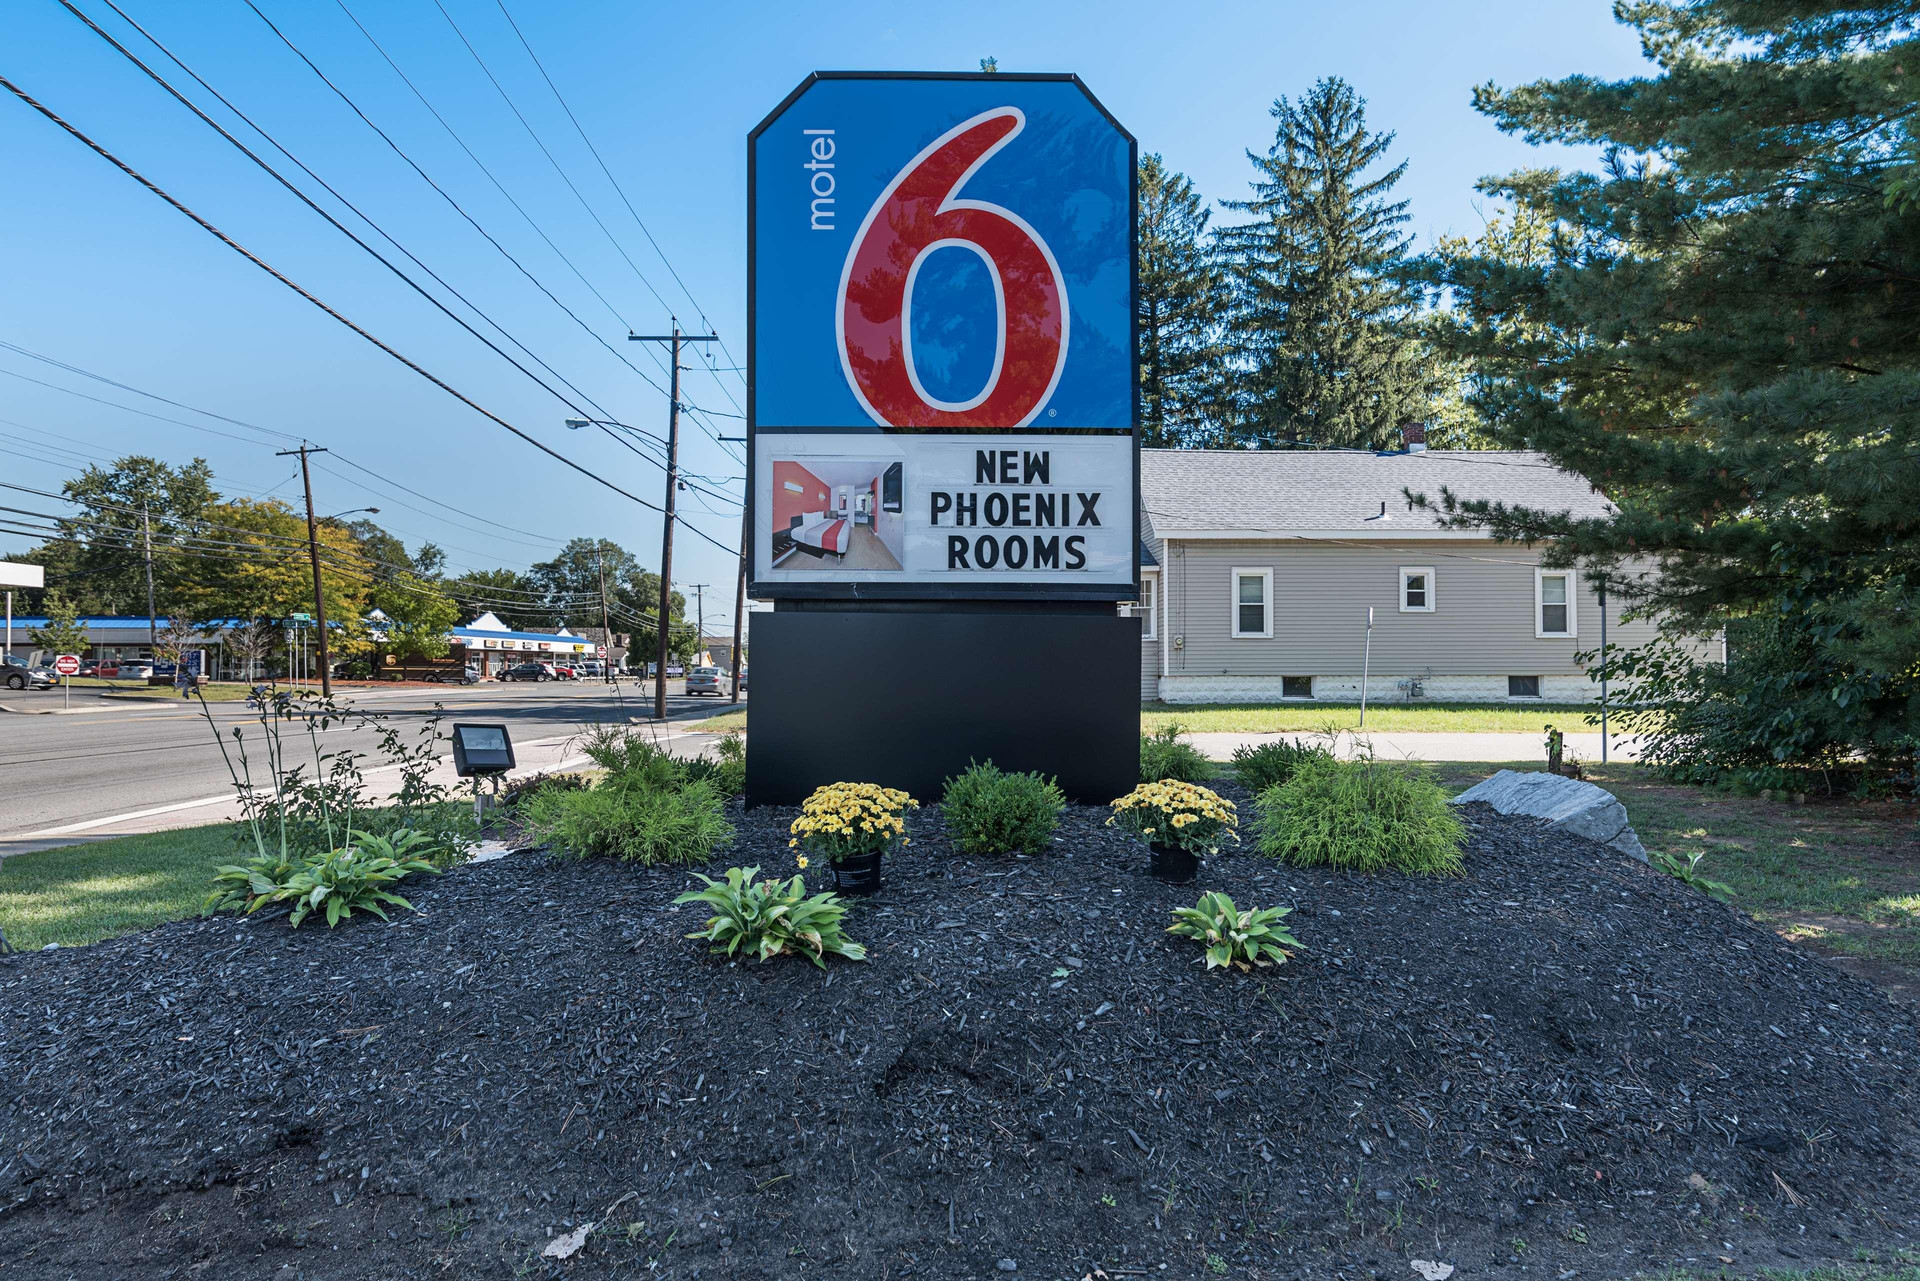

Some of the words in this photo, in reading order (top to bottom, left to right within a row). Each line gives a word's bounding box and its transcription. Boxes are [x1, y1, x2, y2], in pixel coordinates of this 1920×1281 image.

[803, 129, 836, 230] motel
[835, 106, 1070, 427] 6
[976, 450, 1050, 484] NEW
[930, 491, 1101, 527] PHOENIX
[948, 534, 1087, 570] ROOMS
